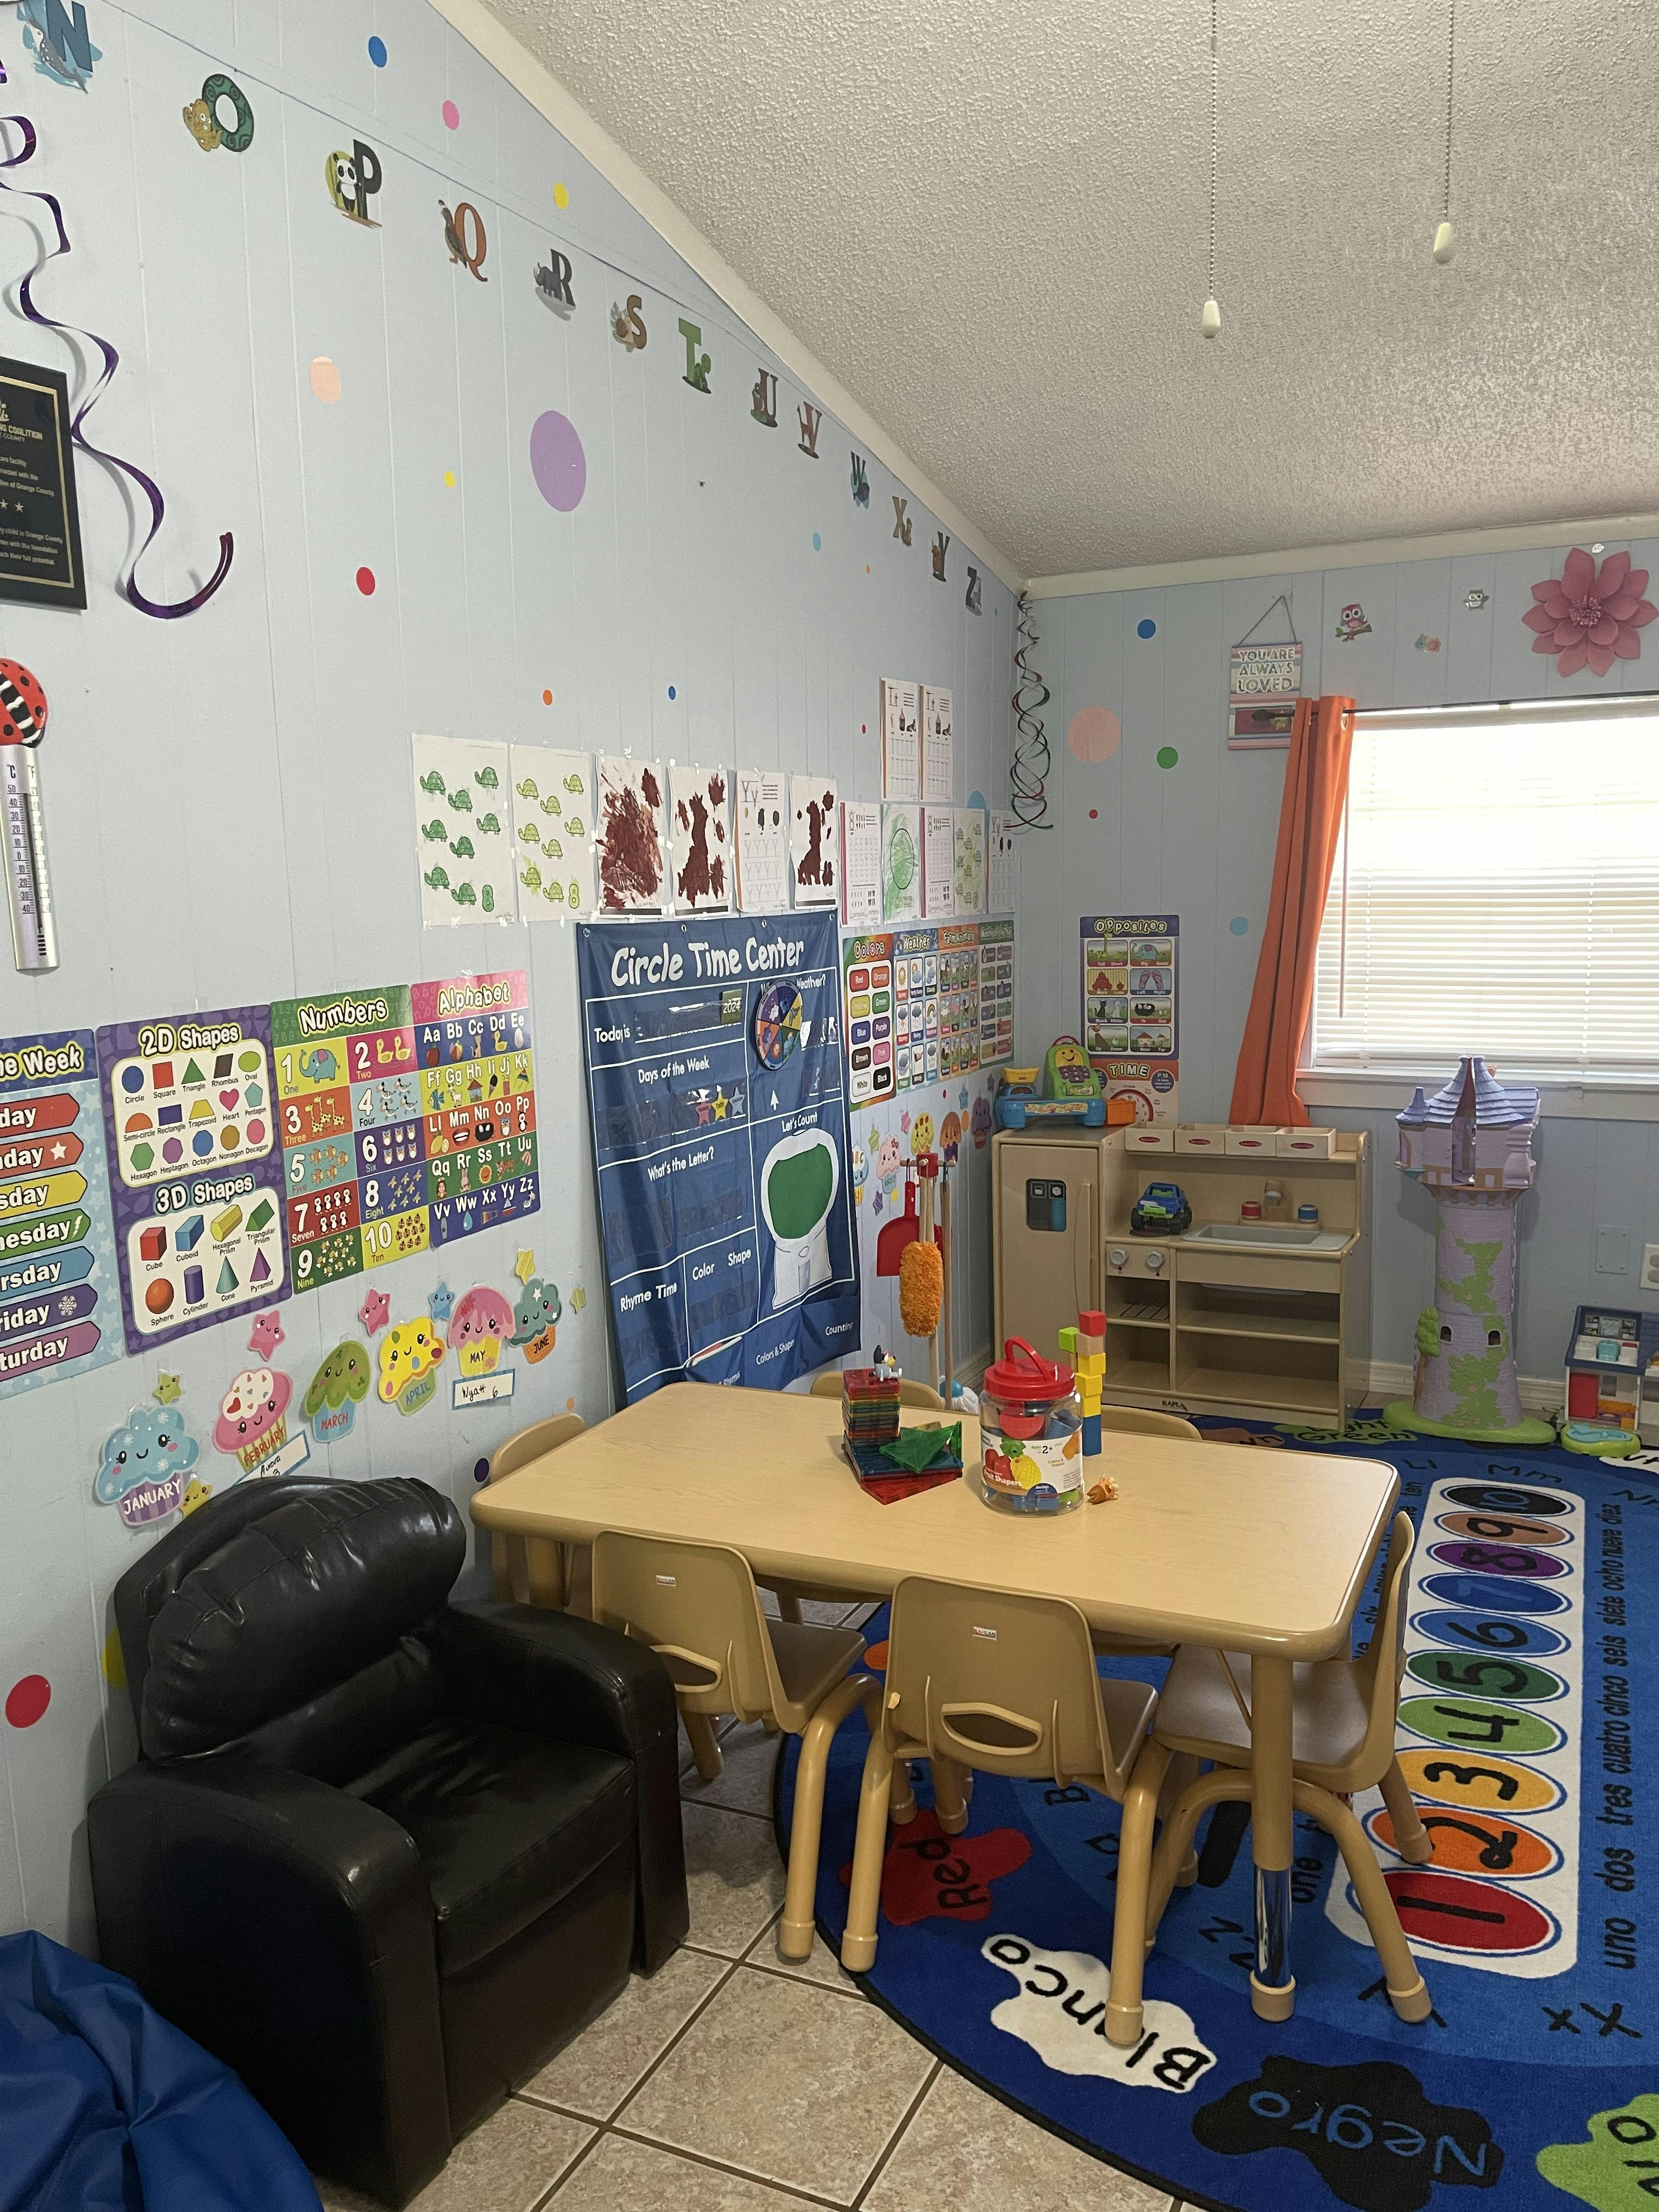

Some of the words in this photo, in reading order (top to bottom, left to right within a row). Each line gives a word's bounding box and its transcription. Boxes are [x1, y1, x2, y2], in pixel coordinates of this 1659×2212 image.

[46, 0, 93, 72] N
[202, 74, 254, 152] O
[353, 139, 382, 219] P
[454, 202, 488, 282] Q
[550, 249, 575, 307] R
[627, 295, 647, 349] S
[679, 317, 702, 383] T
[758, 368, 778, 425] U
[804, 401, 822, 455] V
[892, 496, 909, 540] X
[938, 531, 950, 580] Y
[966, 566, 979, 610] Z
[8, 425, 43, 441] COALITION
[1238, 650, 1267, 662] YOU
[1268, 648, 1295, 661] ARE
[1239, 662, 1294, 676] ALWAYS
[1237, 678, 1294, 693] LOVED
[9, 798, 17, 806] 40
[10, 811, 19, 820] 30
[482, 885, 494, 912] 8
[568, 883, 580, 909] 8
[1095, 919, 1166, 933] Opposites
[854, 940, 885, 959] Colors
[902, 934, 930, 950] Weather
[611, 943, 684, 987] Circle
[689, 941, 742, 978] Time
[745, 936, 804, 972] Center
[796, 973, 826, 990] Weather?
[855, 975, 864, 984] Red
[439, 982, 510, 1015] Alphabet
[723, 1000, 741, 1014] 2024
[875, 999, 887, 1007] Green
[299, 999, 387, 1034] Numbers
[424, 1027, 441, 1043] Aa
[447, 1022, 463, 1039] Bb
[468, 1019, 484, 1035] Cc
[489, 1014, 506, 1031] Dd
[511, 1012, 524, 1028] Ee
[594, 1025, 623, 1043] Today
[623, 1024, 630, 1039] is
[857, 1028, 866, 1037] Blue
[876, 1023, 888, 1034] Purple
[140, 1027, 174, 1057] 2D
[179, 1025, 239, 1051] Shapes
[21, 1043, 81, 1076] Week
[354, 1041, 371, 1070] 2
[281, 1053, 292, 1083] 1
[357, 1071, 371, 1079] Two
[637, 1069, 658, 1084] Days
[661, 1067, 672, 1079] of
[672, 1064, 685, 1076] the
[686, 1055, 710, 1073] Week
[1109, 1063, 1150, 1077] TIME
[211, 1076, 238, 1087] Rhombus
[284, 1086, 299, 1094] One
[125, 1095, 145, 1104] Circle
[153, 1089, 176, 1099] Square
[358, 1088, 373, 1116] 4
[223, 1113, 240, 1121] Heart
[285, 1105, 301, 1134] 3
[359, 1118, 376, 1127] Four
[781, 1117, 797, 1133] Let's
[797, 1112, 818, 1126] Count
[219, 1150, 244, 1160] Nonagon
[245, 1144, 269, 1154] Decagon
[362, 1135, 377, 1162] 6
[192, 1156, 217, 1167] Octagon
[290, 1153, 306, 1183] 5
[647, 1161, 671, 1182] What's
[672, 1156, 686, 1171] the
[688, 1146, 714, 1167] Letter?
[131, 1169, 157, 1181] Hexagon
[157, 1184, 187, 1213] 3D
[194, 1176, 254, 1205] Shapes
[365, 1180, 379, 1207] 8
[294, 1203, 308, 1232] 7
[292, 1230, 314, 1243] Seven
[365, 1221, 392, 1254] 10
[146, 1262, 163, 1271] Cube
[176, 1251, 199, 1262] Cuboid
[297, 1249, 313, 1279] 9
[371, 1254, 384, 1263] Ten
[692, 1263, 714, 1280] Color
[728, 1248, 752, 1267] Shape
[221, 1293, 235, 1302] Cone
[250, 1280, 273, 1293] Pyramid
[620, 1291, 652, 1312] Rhyme
[656, 1282, 677, 1299] Time
[151, 1314, 174, 1326] Sphere
[825, 1321, 854, 1336] Counting
[533, 1334, 550, 1354] JUNE
[470, 1350, 486, 1364] MAY
[756, 1351, 774, 1365] Colors
[775, 1347, 779, 1356] &
[405, 1382, 431, 1406] APRIL
[461, 1384, 487, 1402] Wyatt
[492, 1385, 499, 1401] 6
[320, 1411, 349, 1431] MARCH
[243, 1426, 286, 1466] FEBRUARY
[1297, 1432, 1412, 1441] Green
[1042, 1445, 1053, 1454] 2+
[260, 1455, 281, 1477] Aurora
[1487, 1463, 1563, 1483] Mm
[995, 1475, 1023, 1487] Shapers
[123, 1479, 181, 1516] JANUARY
[1466, 1517, 1548, 1537] 9
[1460, 1546, 1537, 1572] 8
[1595, 1559, 1625, 1591] ocho
[1454, 1577, 1534, 1602] 7
[1595, 1595, 1627, 1627] siete
[1446, 1622, 1528, 1647] 6
[1596, 1635, 1628, 1667] seis
[1436, 1660, 1528, 1694] 5
[1596, 1675, 1630, 1717] cinco
[1434, 1705, 1520, 1743] 4
[1595, 1720, 1633, 1775] cuatro
[1424, 1762, 1519, 1801] 3
[1595, 1783, 1634, 1827] tres
[1420, 1817, 1518, 1870] 2
[899, 1837, 987, 1910] Red
[1594, 1847, 1636, 1893] dos
[1396, 1895, 1505, 1925] 1
[1604, 1916, 1637, 1970] uno
[989, 1938, 1211, 2091] Blnco
[1542, 2004, 1642, 2038] Xx
[1248, 2090, 1487, 2177] Negro
